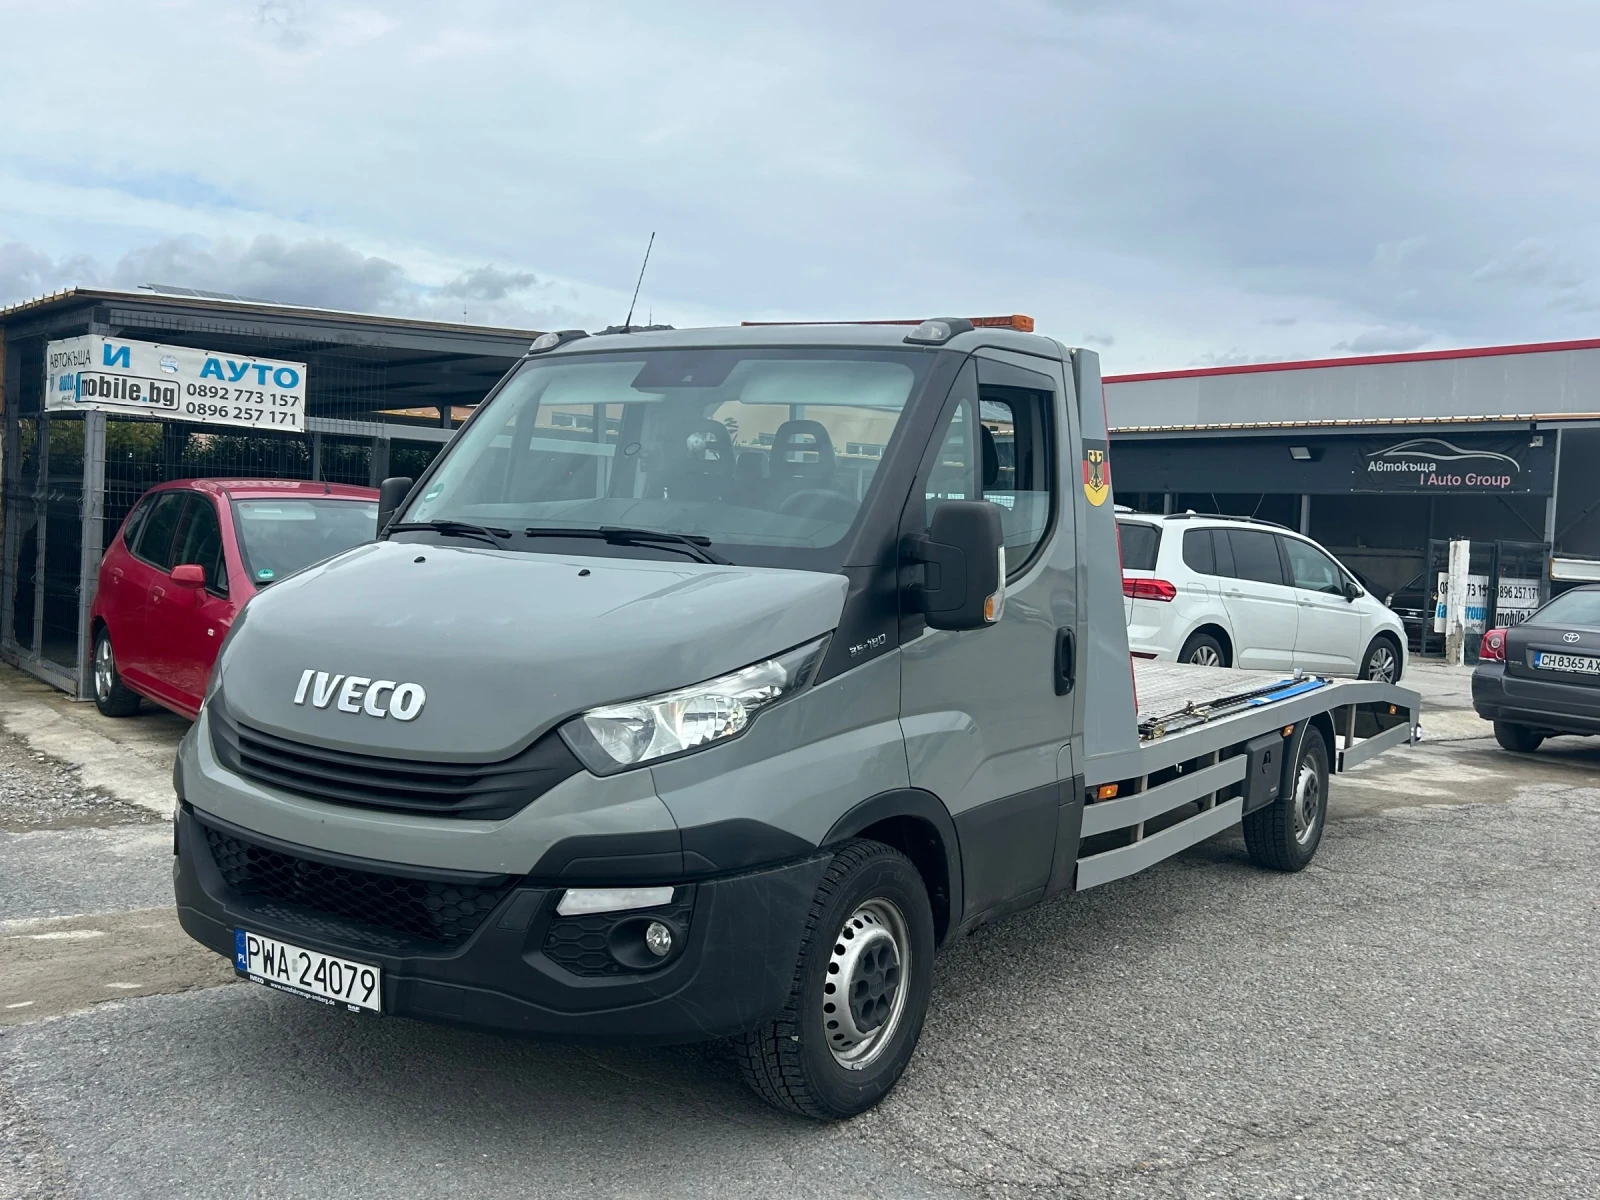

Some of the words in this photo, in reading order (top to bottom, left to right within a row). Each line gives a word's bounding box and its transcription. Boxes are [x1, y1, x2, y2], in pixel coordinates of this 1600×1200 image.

[50, 349, 91, 368] АВТОКЪЩА
[103, 343, 131, 368] И
[199, 357, 299, 389] АУТО
[186, 383, 229, 400] 0892
[234, 388, 264, 404] 773
[270, 393, 299, 407] 157
[186, 402, 228, 418] 0896
[233, 406, 264, 421] 257
[269, 411, 296, 426] 171
[1428, 474, 1461, 486] Auto
[1465, 473, 1511, 488] Group
[1514, 586, 1526, 598] 257
[1557, 656, 1585, 669] 8365
[293, 669, 427, 721] IVECO
[238, 953, 246, 964] PL
[247, 935, 290, 981] PWA
[298, 951, 376, 1003] 24079
